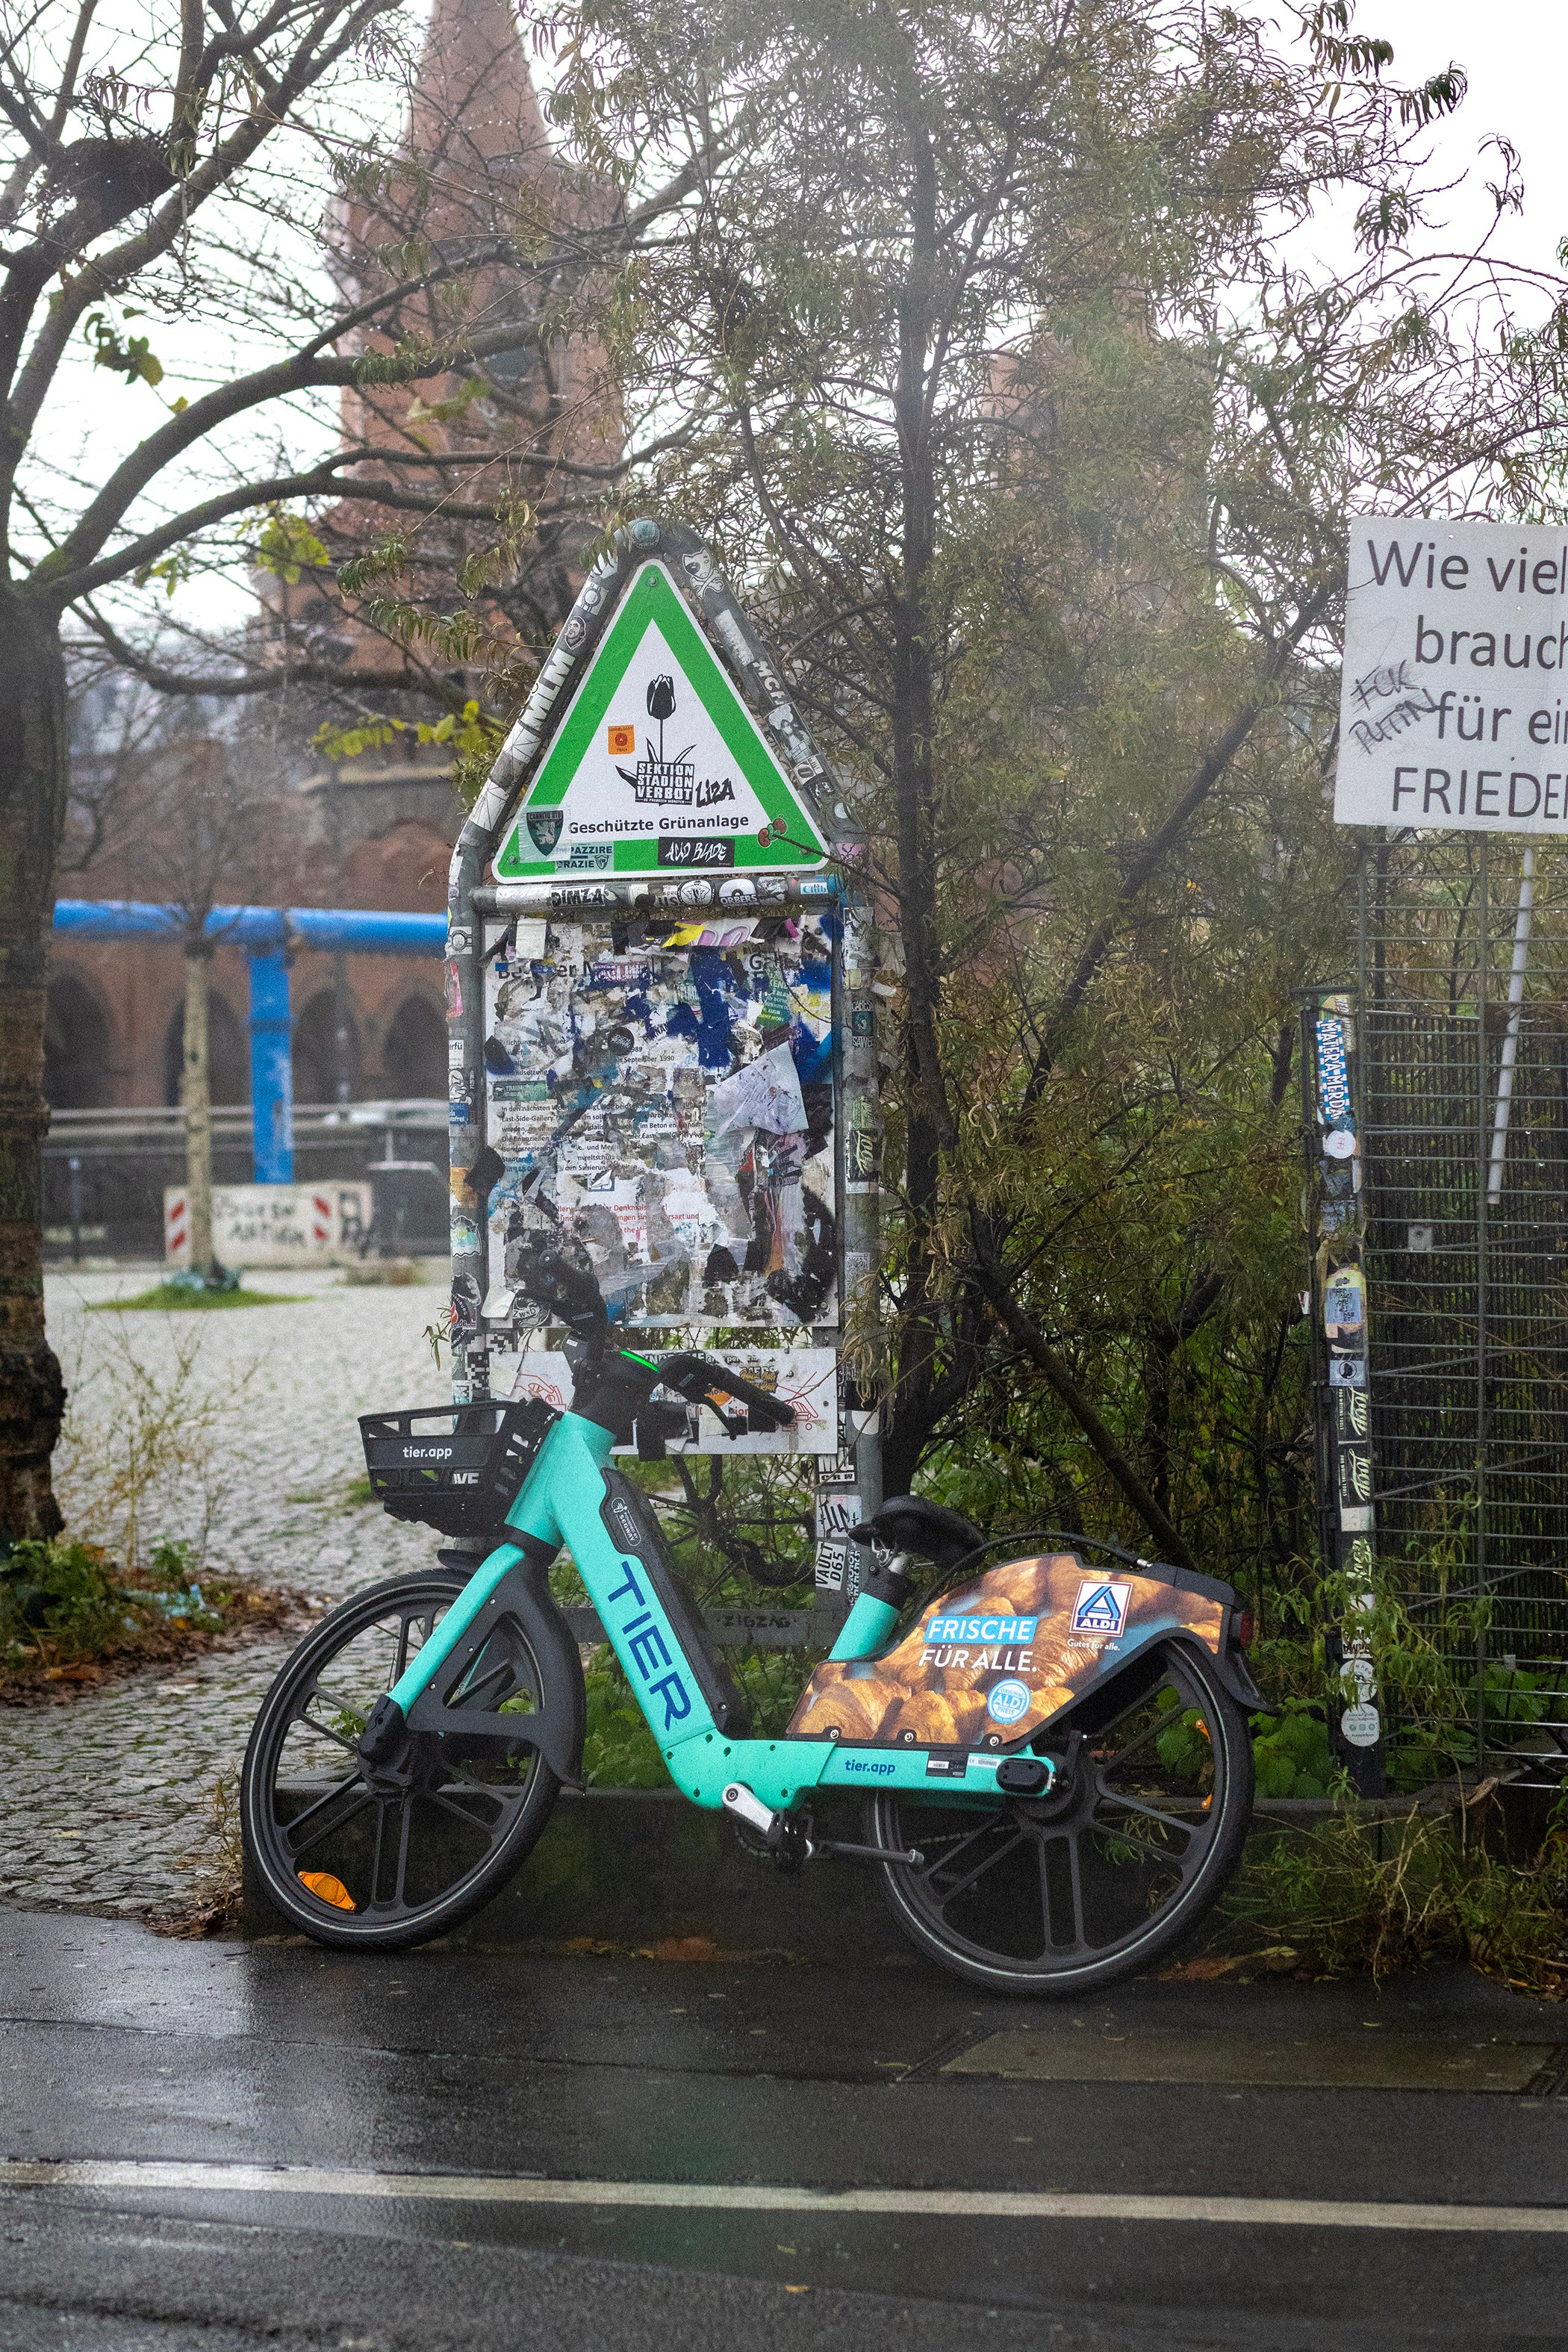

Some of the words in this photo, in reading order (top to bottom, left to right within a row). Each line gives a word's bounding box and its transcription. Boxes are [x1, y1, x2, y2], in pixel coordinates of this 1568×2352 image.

[1367, 540, 1469, 591] Wie
[1436, 691, 1511, 741] für
[638, 762, 694, 776] SEKTION
[637, 774, 693, 788] STADION
[637, 785, 692, 800] VERBOT
[570, 818, 654, 834] Geschützte
[659, 815, 749, 830] Grünanlage
[402, 1446, 452, 1460] tier.app
[620, 1514, 635, 1541] SEGWAY
[815, 1542, 834, 1586] VAULT
[830, 1552, 845, 1582] D65
[928, 1620, 1033, 1641] FRISCHE
[1080, 1619, 1117, 1630] ALDI
[608, 1561, 691, 1732] TIER
[1067, 1638, 1090, 1648] Gutes
[1104, 1640, 1120, 1651] alle.
[918, 1645, 970, 1669] FÜR
[971, 1650, 1038, 1673] ALLE.
[993, 1693, 1025, 1711] ALDI
[1000, 1688, 1024, 1698] ORIGINAL
[997, 1705, 1015, 1715] PREIS
[844, 1760, 896, 1775] tier.app
